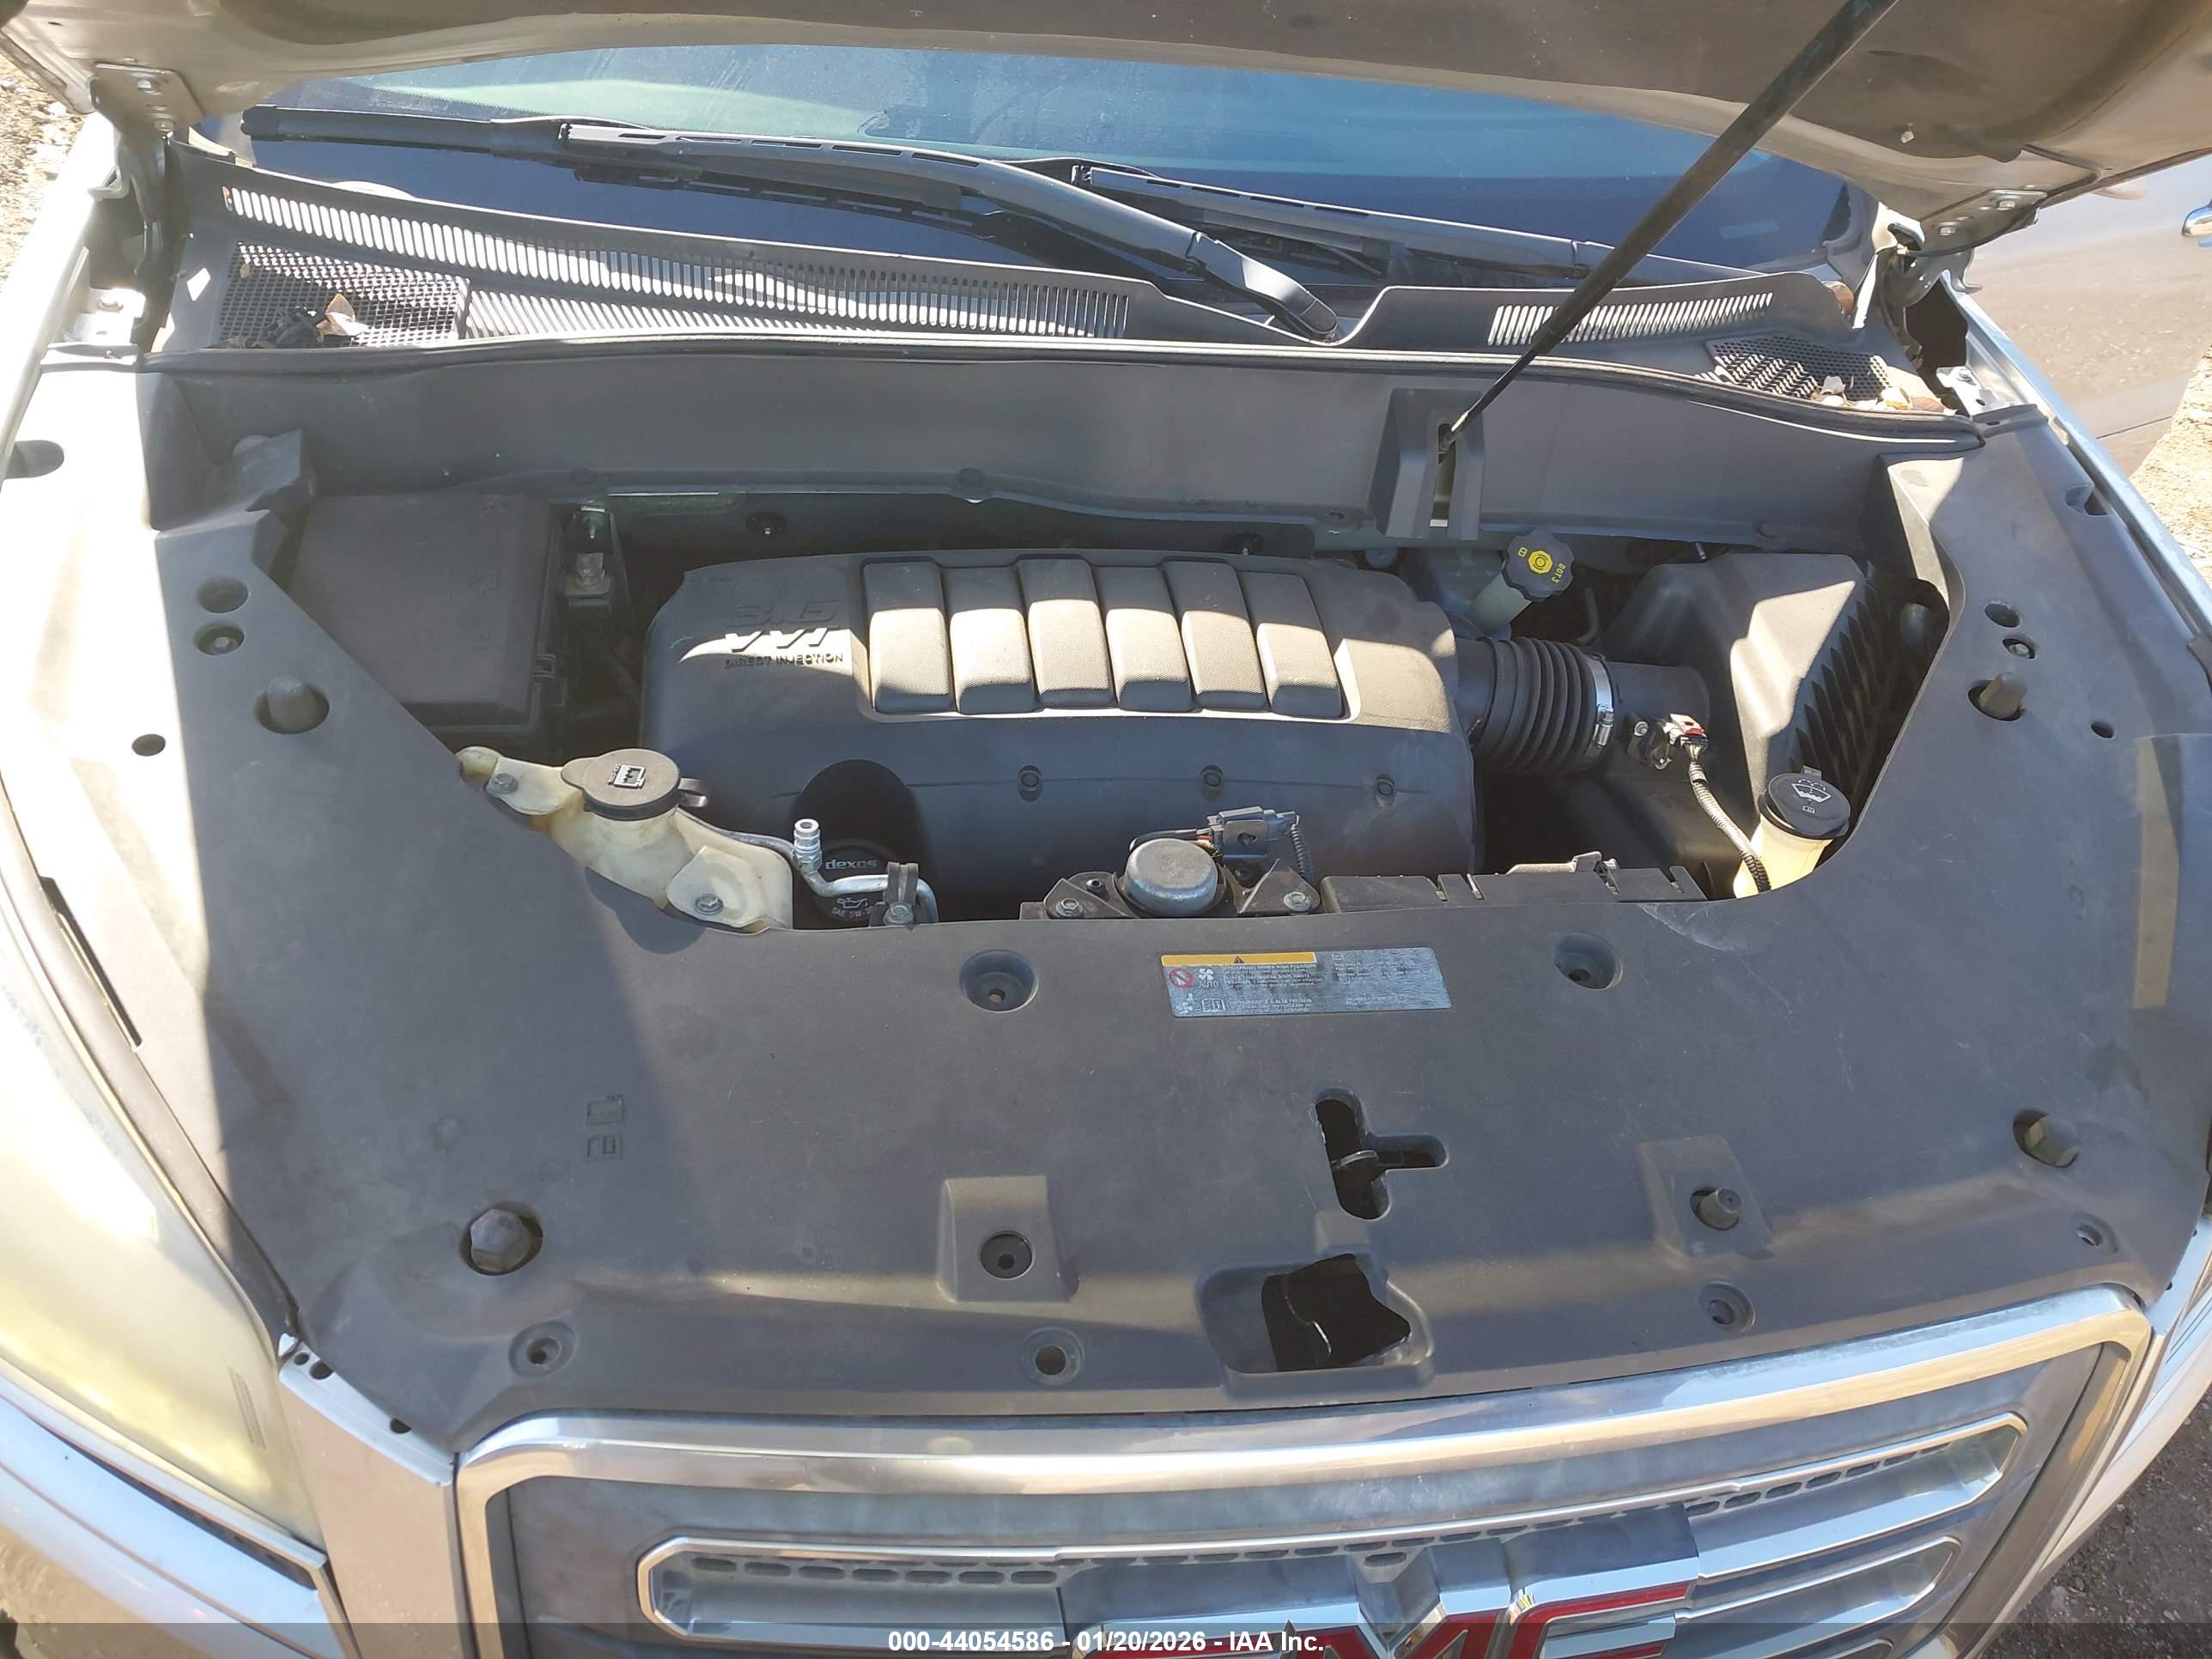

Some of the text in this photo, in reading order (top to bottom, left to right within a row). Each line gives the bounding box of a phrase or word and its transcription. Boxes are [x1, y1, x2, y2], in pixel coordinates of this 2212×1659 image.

[724, 626, 841, 653] VVT
[724, 653, 844, 668] DIRECT INJECTION
[825, 859, 878, 870] dexos
